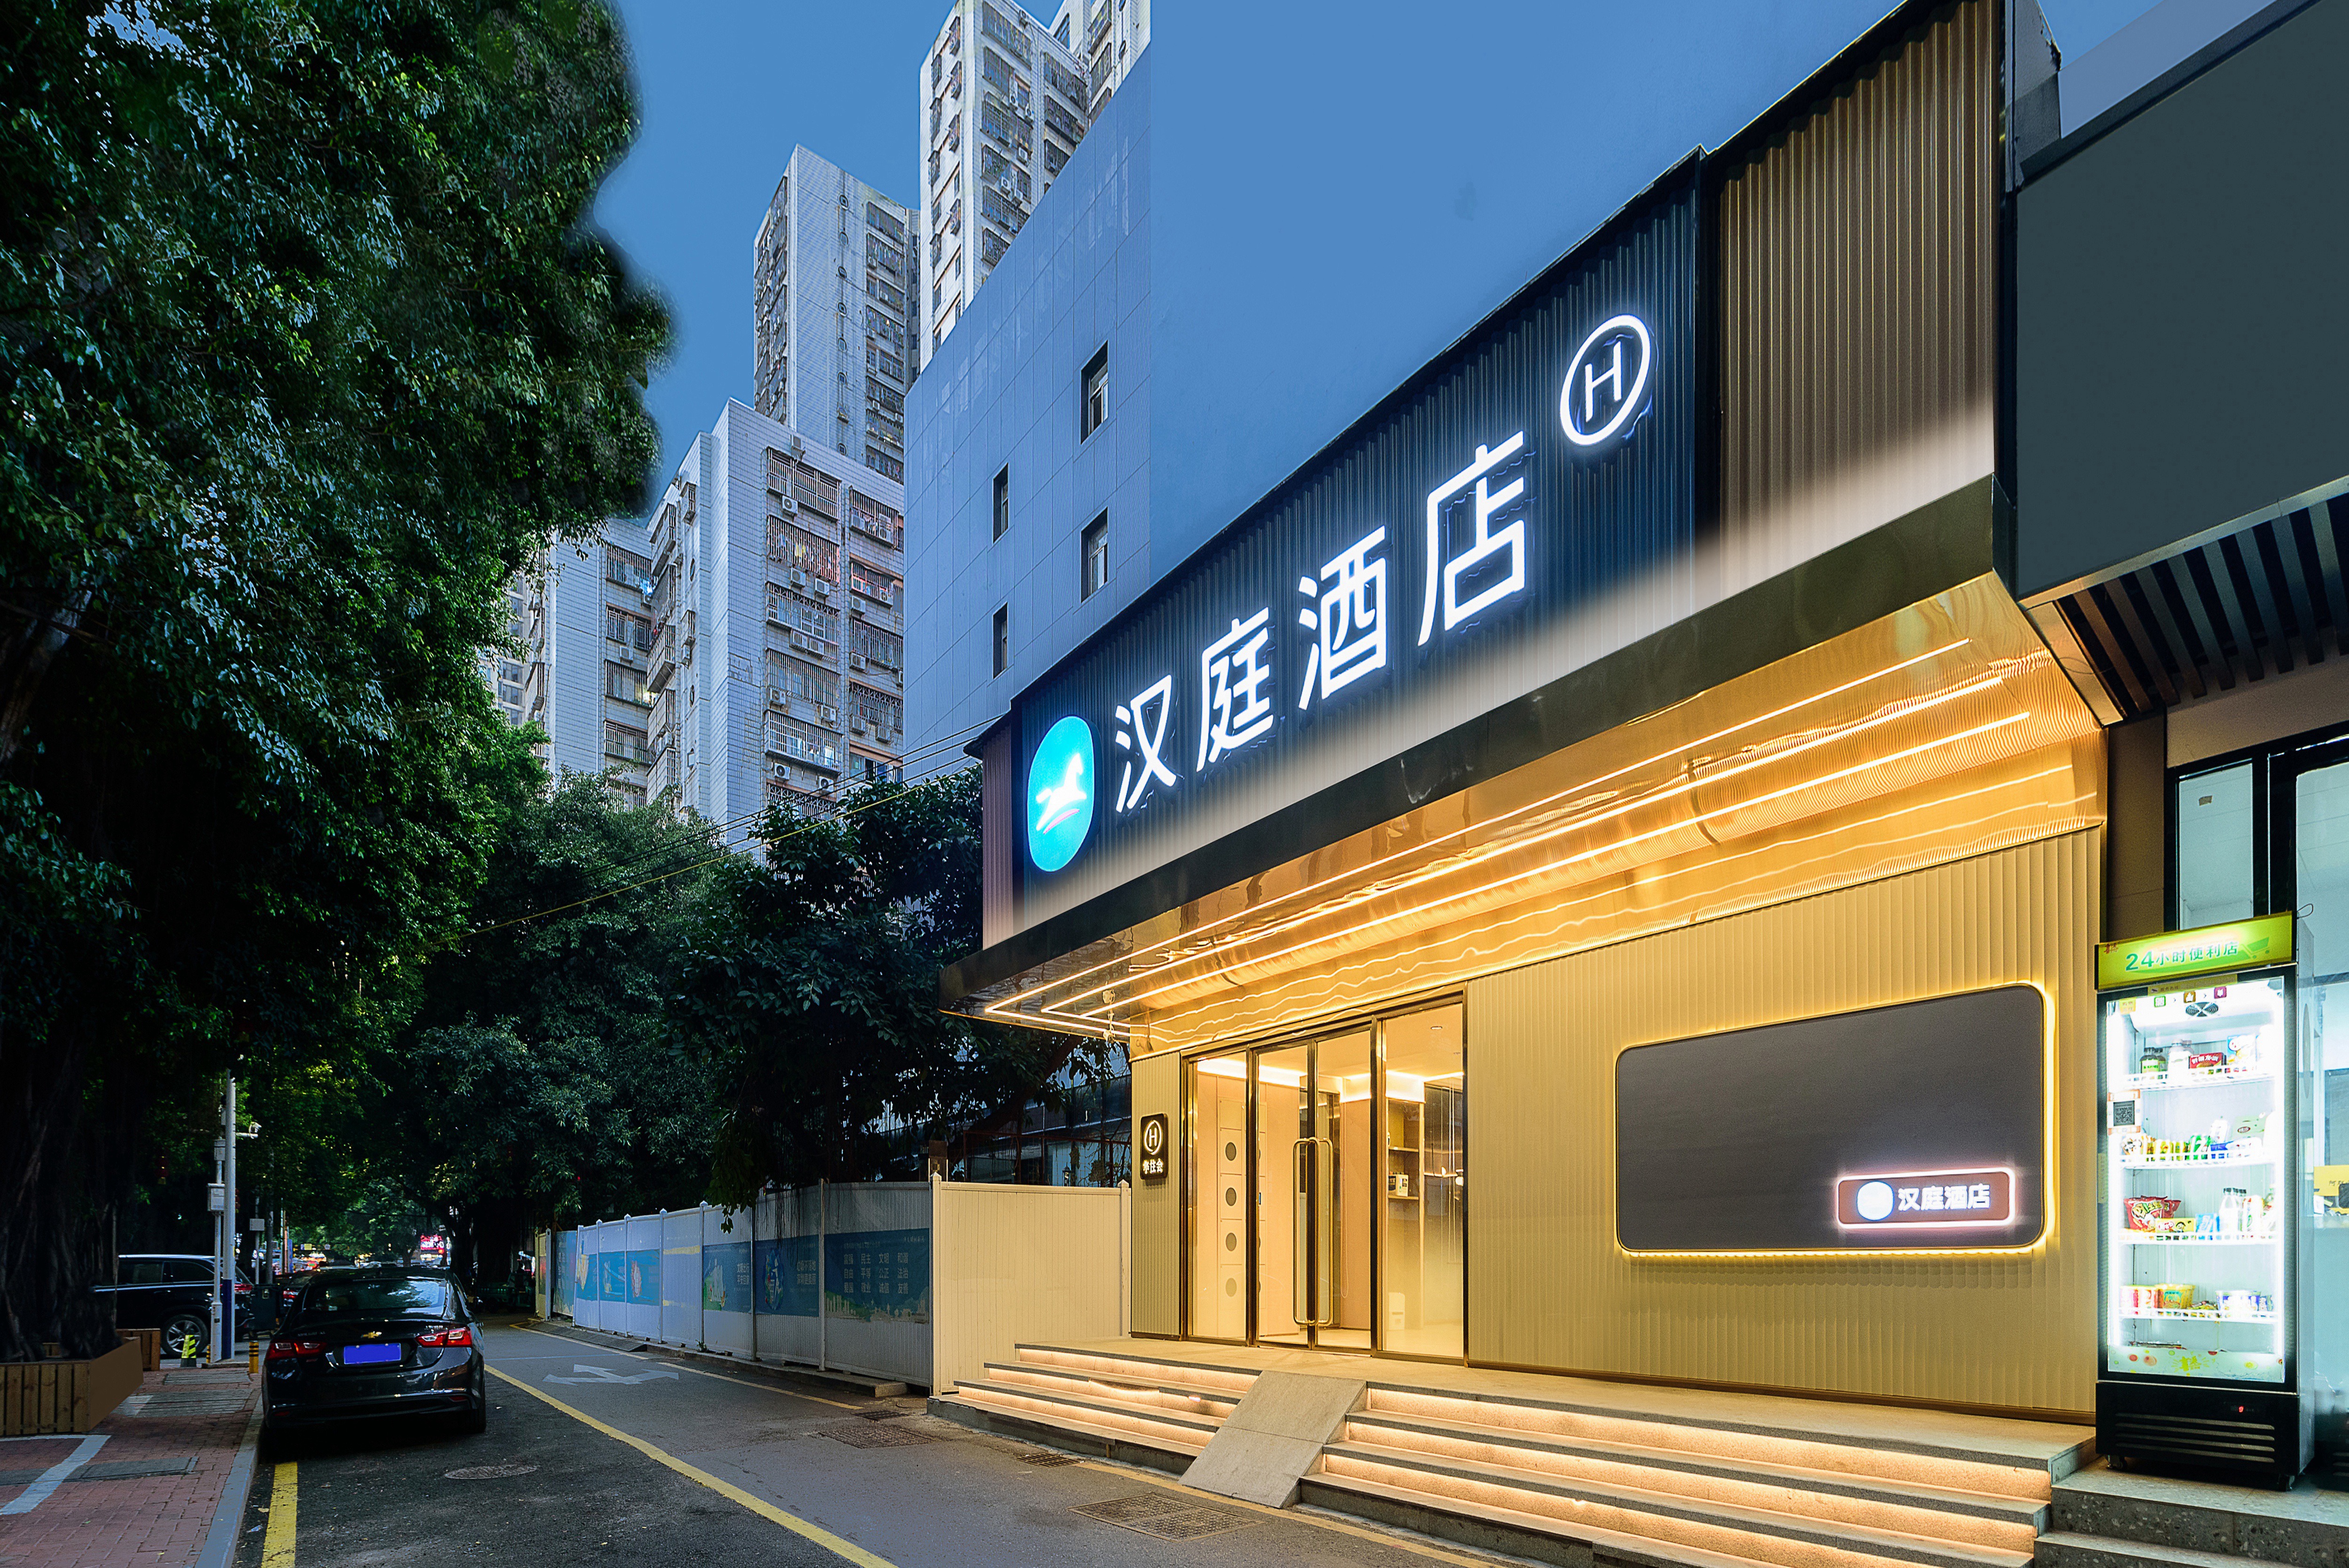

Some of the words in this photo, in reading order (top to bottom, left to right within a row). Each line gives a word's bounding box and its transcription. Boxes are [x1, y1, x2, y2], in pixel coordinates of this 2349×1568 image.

[1115, 430, 1525, 813] 汉庭酒店
[2125, 942, 2239, 971] 24小时便利店
[1898, 1183, 1991, 1212] 汉庭酒店
[844, 1253, 854, 1265] 富强
[861, 1253, 871, 1265] 民主
[879, 1252, 889, 1264] 文明
[897, 1252, 909, 1264] 和谐
[844, 1268, 854, 1279] 自由
[861, 1268, 871, 1279] 平等
[879, 1267, 889, 1279] 公正
[897, 1267, 909, 1279] 法治
[844, 1282, 854, 1293] 爱国
[861, 1282, 871, 1293] 敬业
[879, 1282, 889, 1294] 诚信
[897, 1282, 909, 1294] 友善
